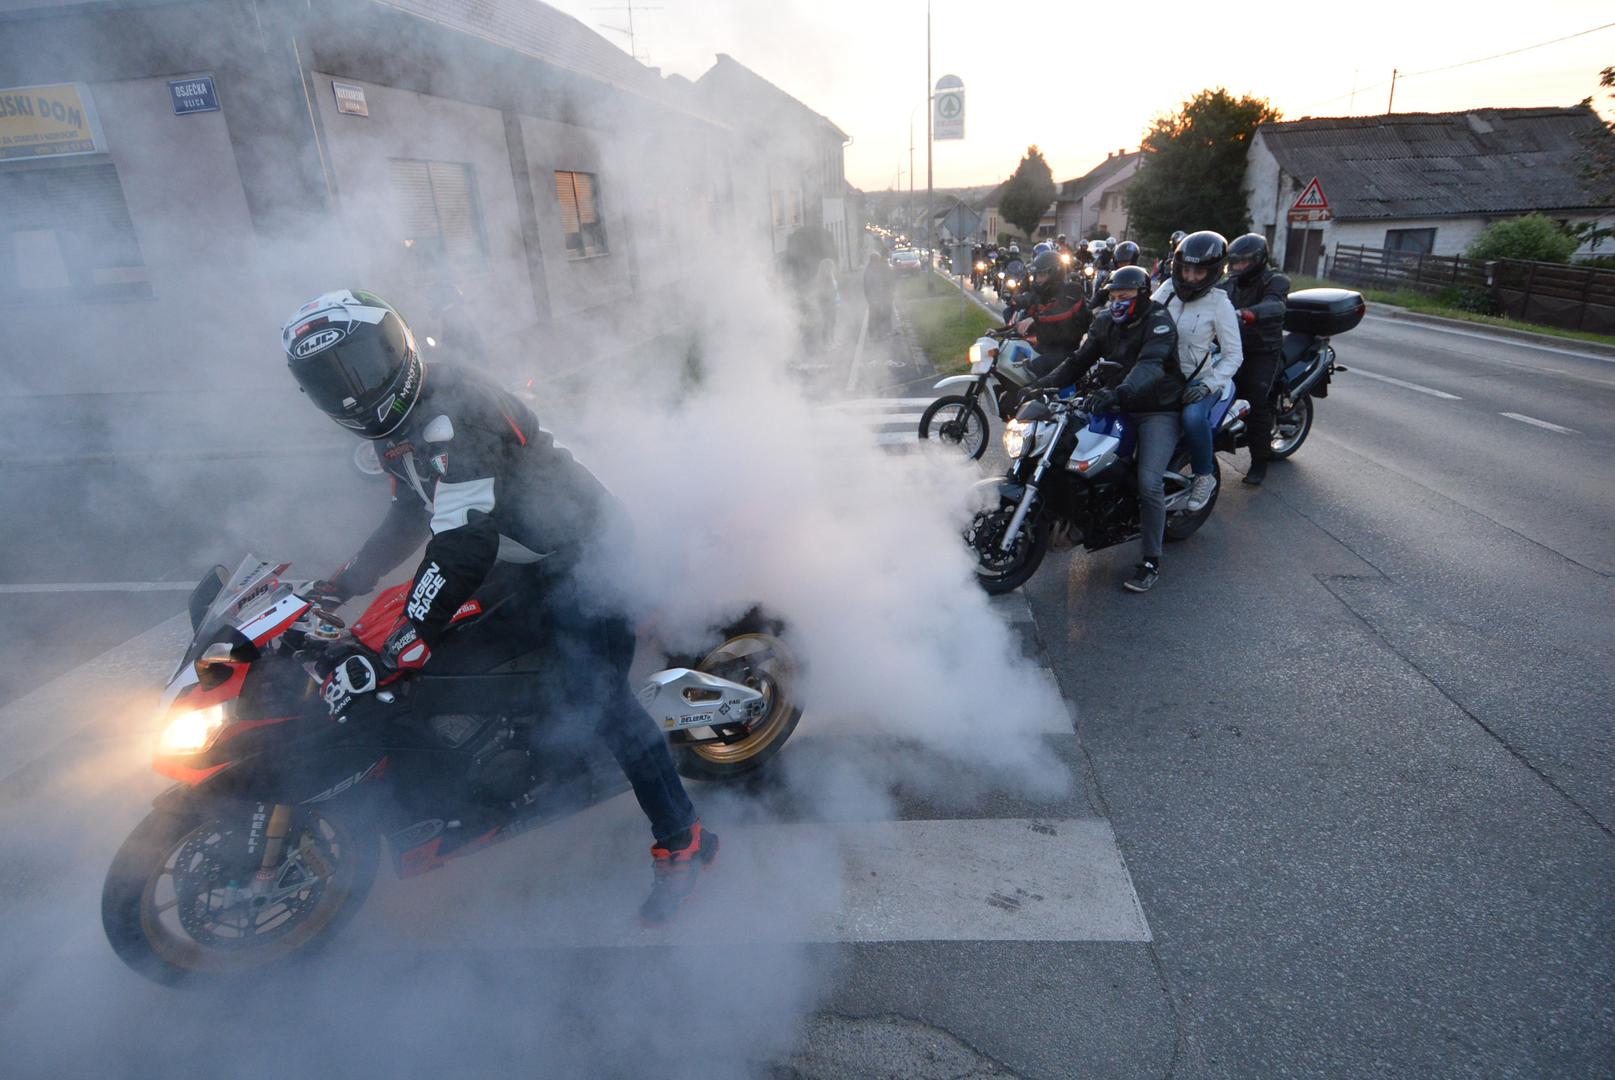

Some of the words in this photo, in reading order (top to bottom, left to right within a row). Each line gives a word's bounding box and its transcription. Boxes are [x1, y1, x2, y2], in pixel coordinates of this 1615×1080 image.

[175, 83, 208, 97] OSJEČKA
[38, 96, 82, 129] DOM
[184, 98, 205, 108] ULICA
[299, 331, 335, 355] HJC
[414, 574, 447, 621] RACE
